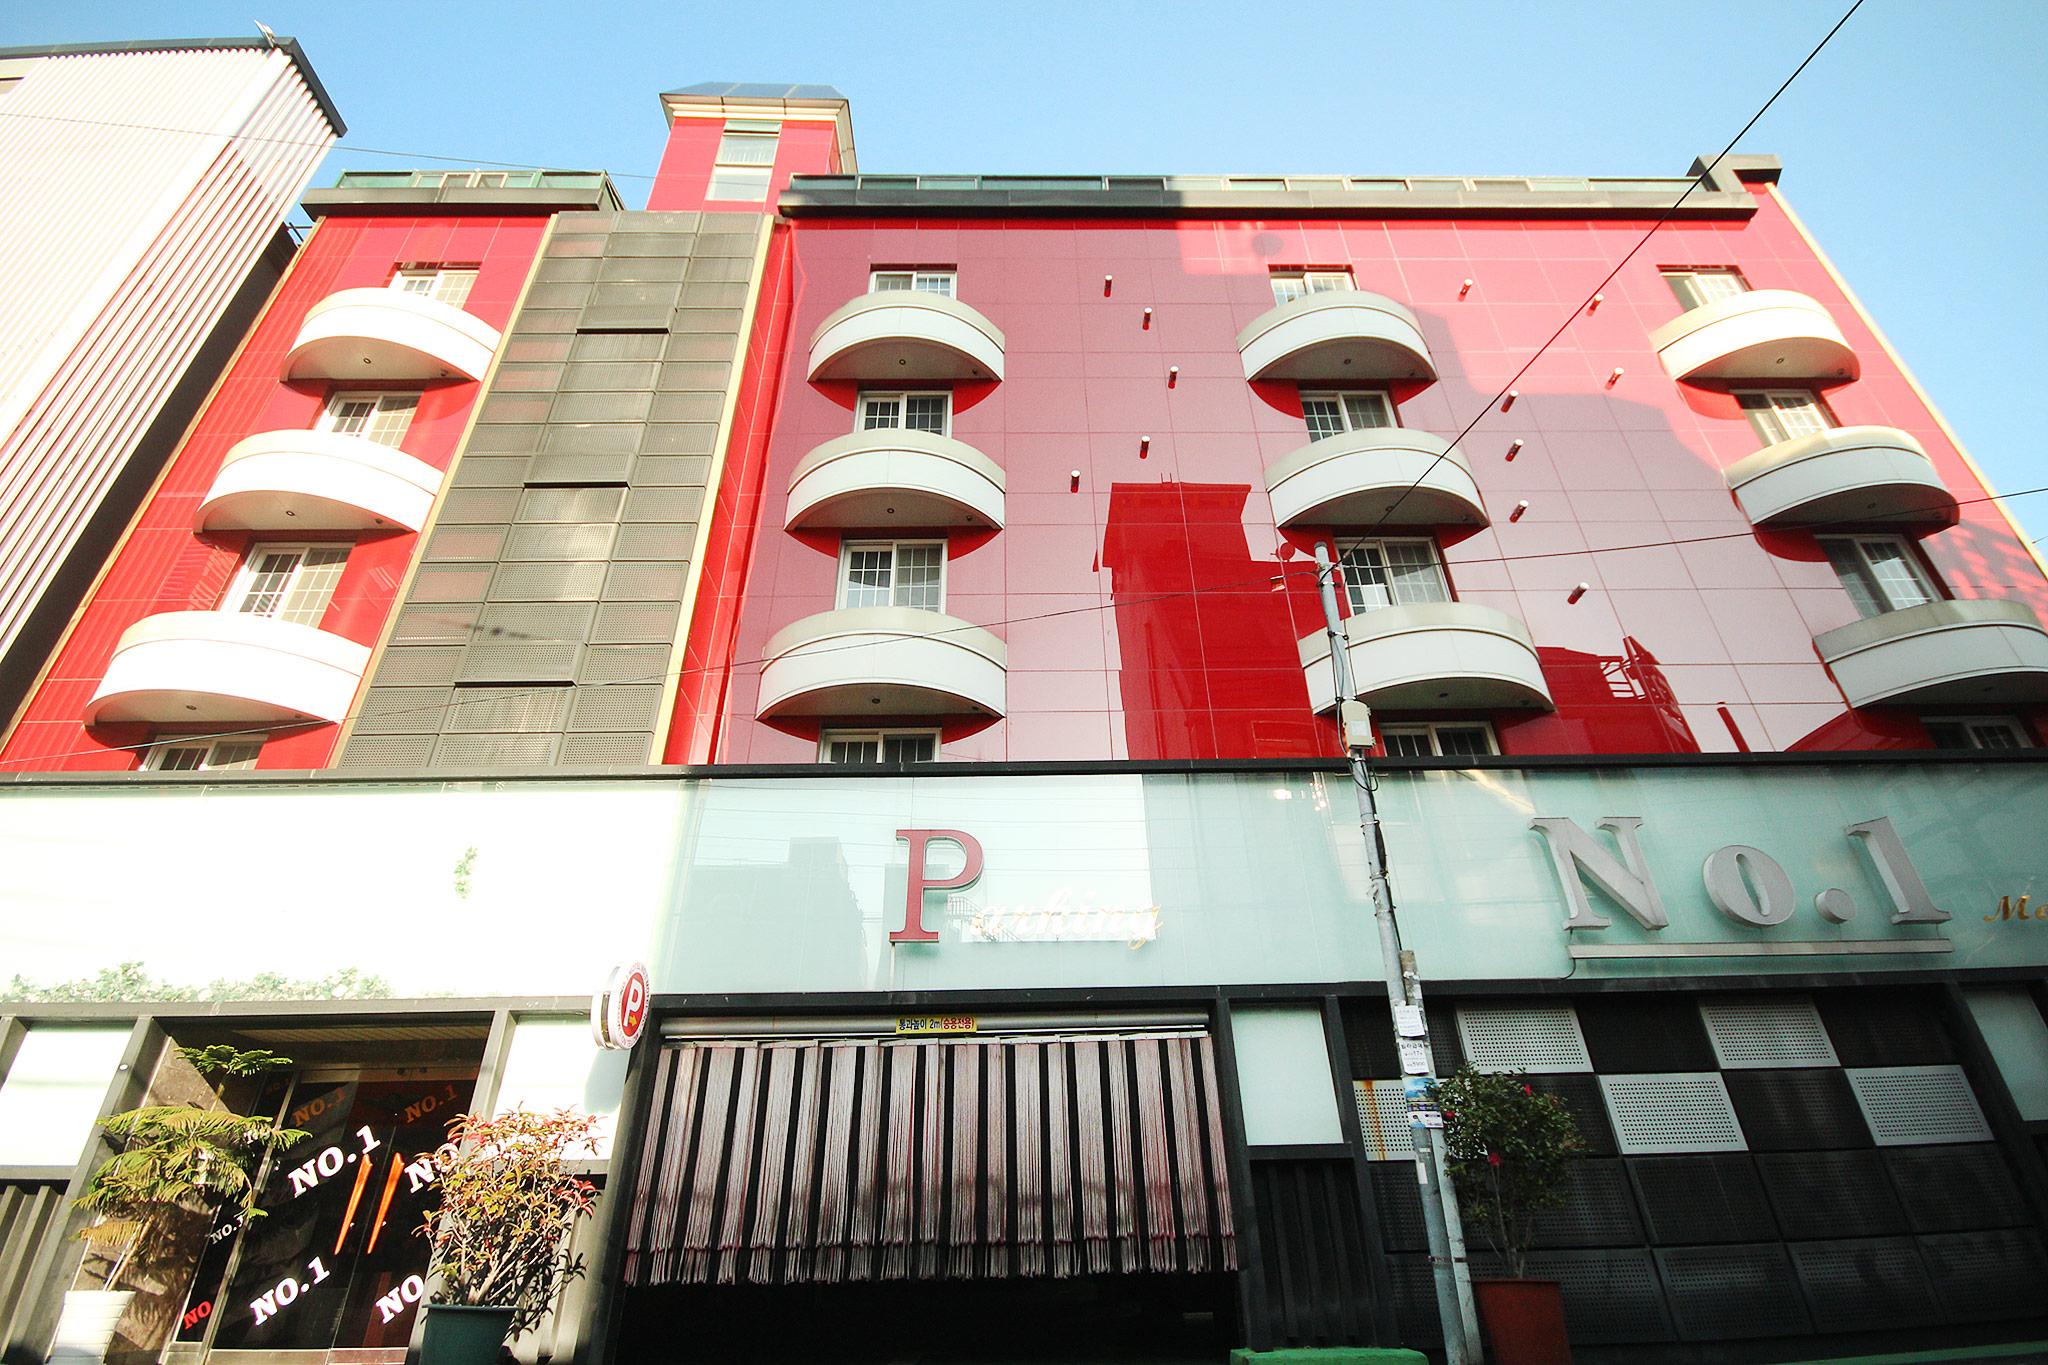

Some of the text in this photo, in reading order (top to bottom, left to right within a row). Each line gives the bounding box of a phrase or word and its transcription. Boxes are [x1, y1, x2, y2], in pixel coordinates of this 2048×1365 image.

[1528, 816, 1953, 931] No.1
[623, 978, 644, 1027] P
[899, 1018, 927, 1030] 통과높이
[291, 1087, 347, 1127] NO.1
[404, 1084, 458, 1124] NO.1
[288, 1124, 381, 1199] NO.1
[250, 1256, 331, 1327] NO.1
[183, 1300, 212, 1330] NO
